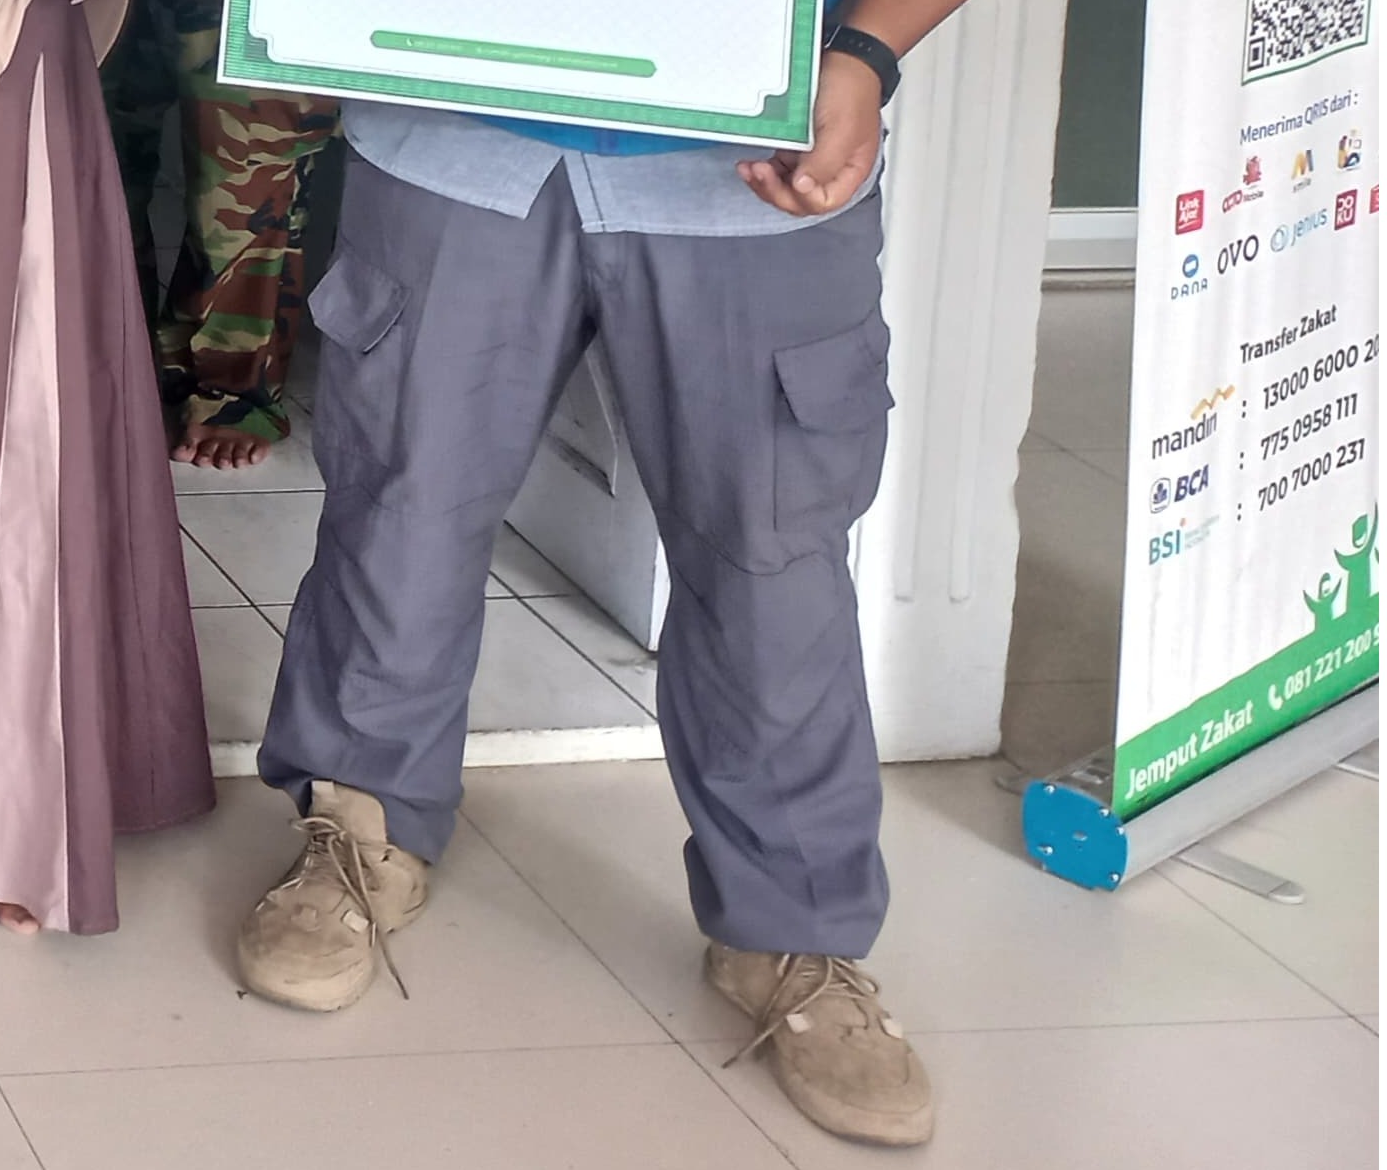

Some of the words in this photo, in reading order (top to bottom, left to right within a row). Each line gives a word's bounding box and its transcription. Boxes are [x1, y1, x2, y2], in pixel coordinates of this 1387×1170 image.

[1239, 116, 1303, 145] Menerima
[1304, 98, 1329, 125] QRIS
[1330, 89, 1352, 113] dari
[1217, 234, 1259, 275] OVO
[1170, 278, 1208, 300] DANA
[1240, 324, 1299, 364] Transfer
[1299, 303, 1337, 338] Zakat
[1263, 365, 1309, 410] 13000
[1313, 344, 1358, 382] 6000
[1174, 464, 1210, 503] BCA
[1260, 426, 1289, 460] 775
[1292, 403, 1331, 442] 0958
[1336, 393, 1358, 420] 111
[1148, 528, 1181, 566] BSI
[1258, 476, 1288, 511] 700
[1291, 451, 1332, 492] 7000
[1335, 438, 1365, 469] 231
[1125, 731, 1198, 800] Jemput
[1199, 699, 1253, 754] Zakat
[1284, 665, 1311, 700] 081
[1314, 646, 1342, 682] 221
[1343, 628, 1372, 664] 200
